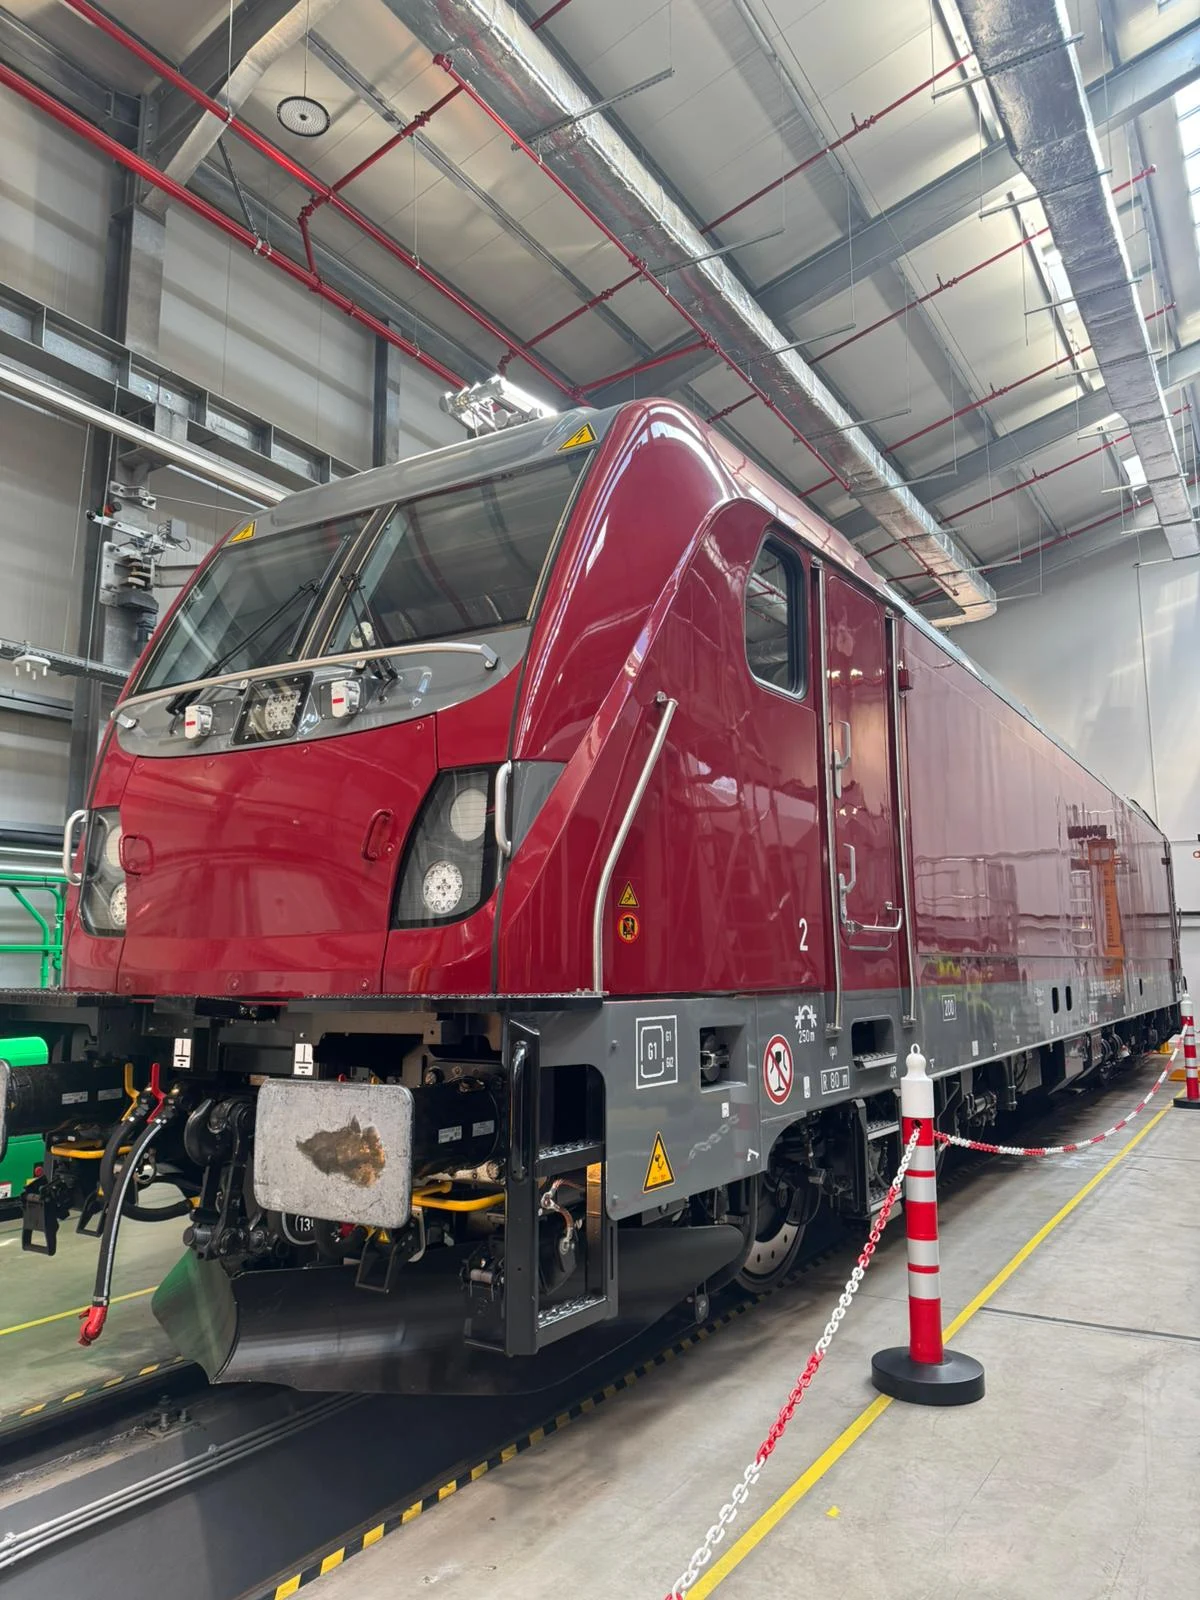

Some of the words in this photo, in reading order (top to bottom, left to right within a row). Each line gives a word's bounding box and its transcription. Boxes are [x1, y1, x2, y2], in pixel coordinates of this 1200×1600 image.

[799, 918, 809, 951] 2
[648, 1042, 657, 1060] G1
[822, 1074, 828, 1091] R
[830, 1071, 840, 1088] 80
[842, 1074, 848, 1087] m
